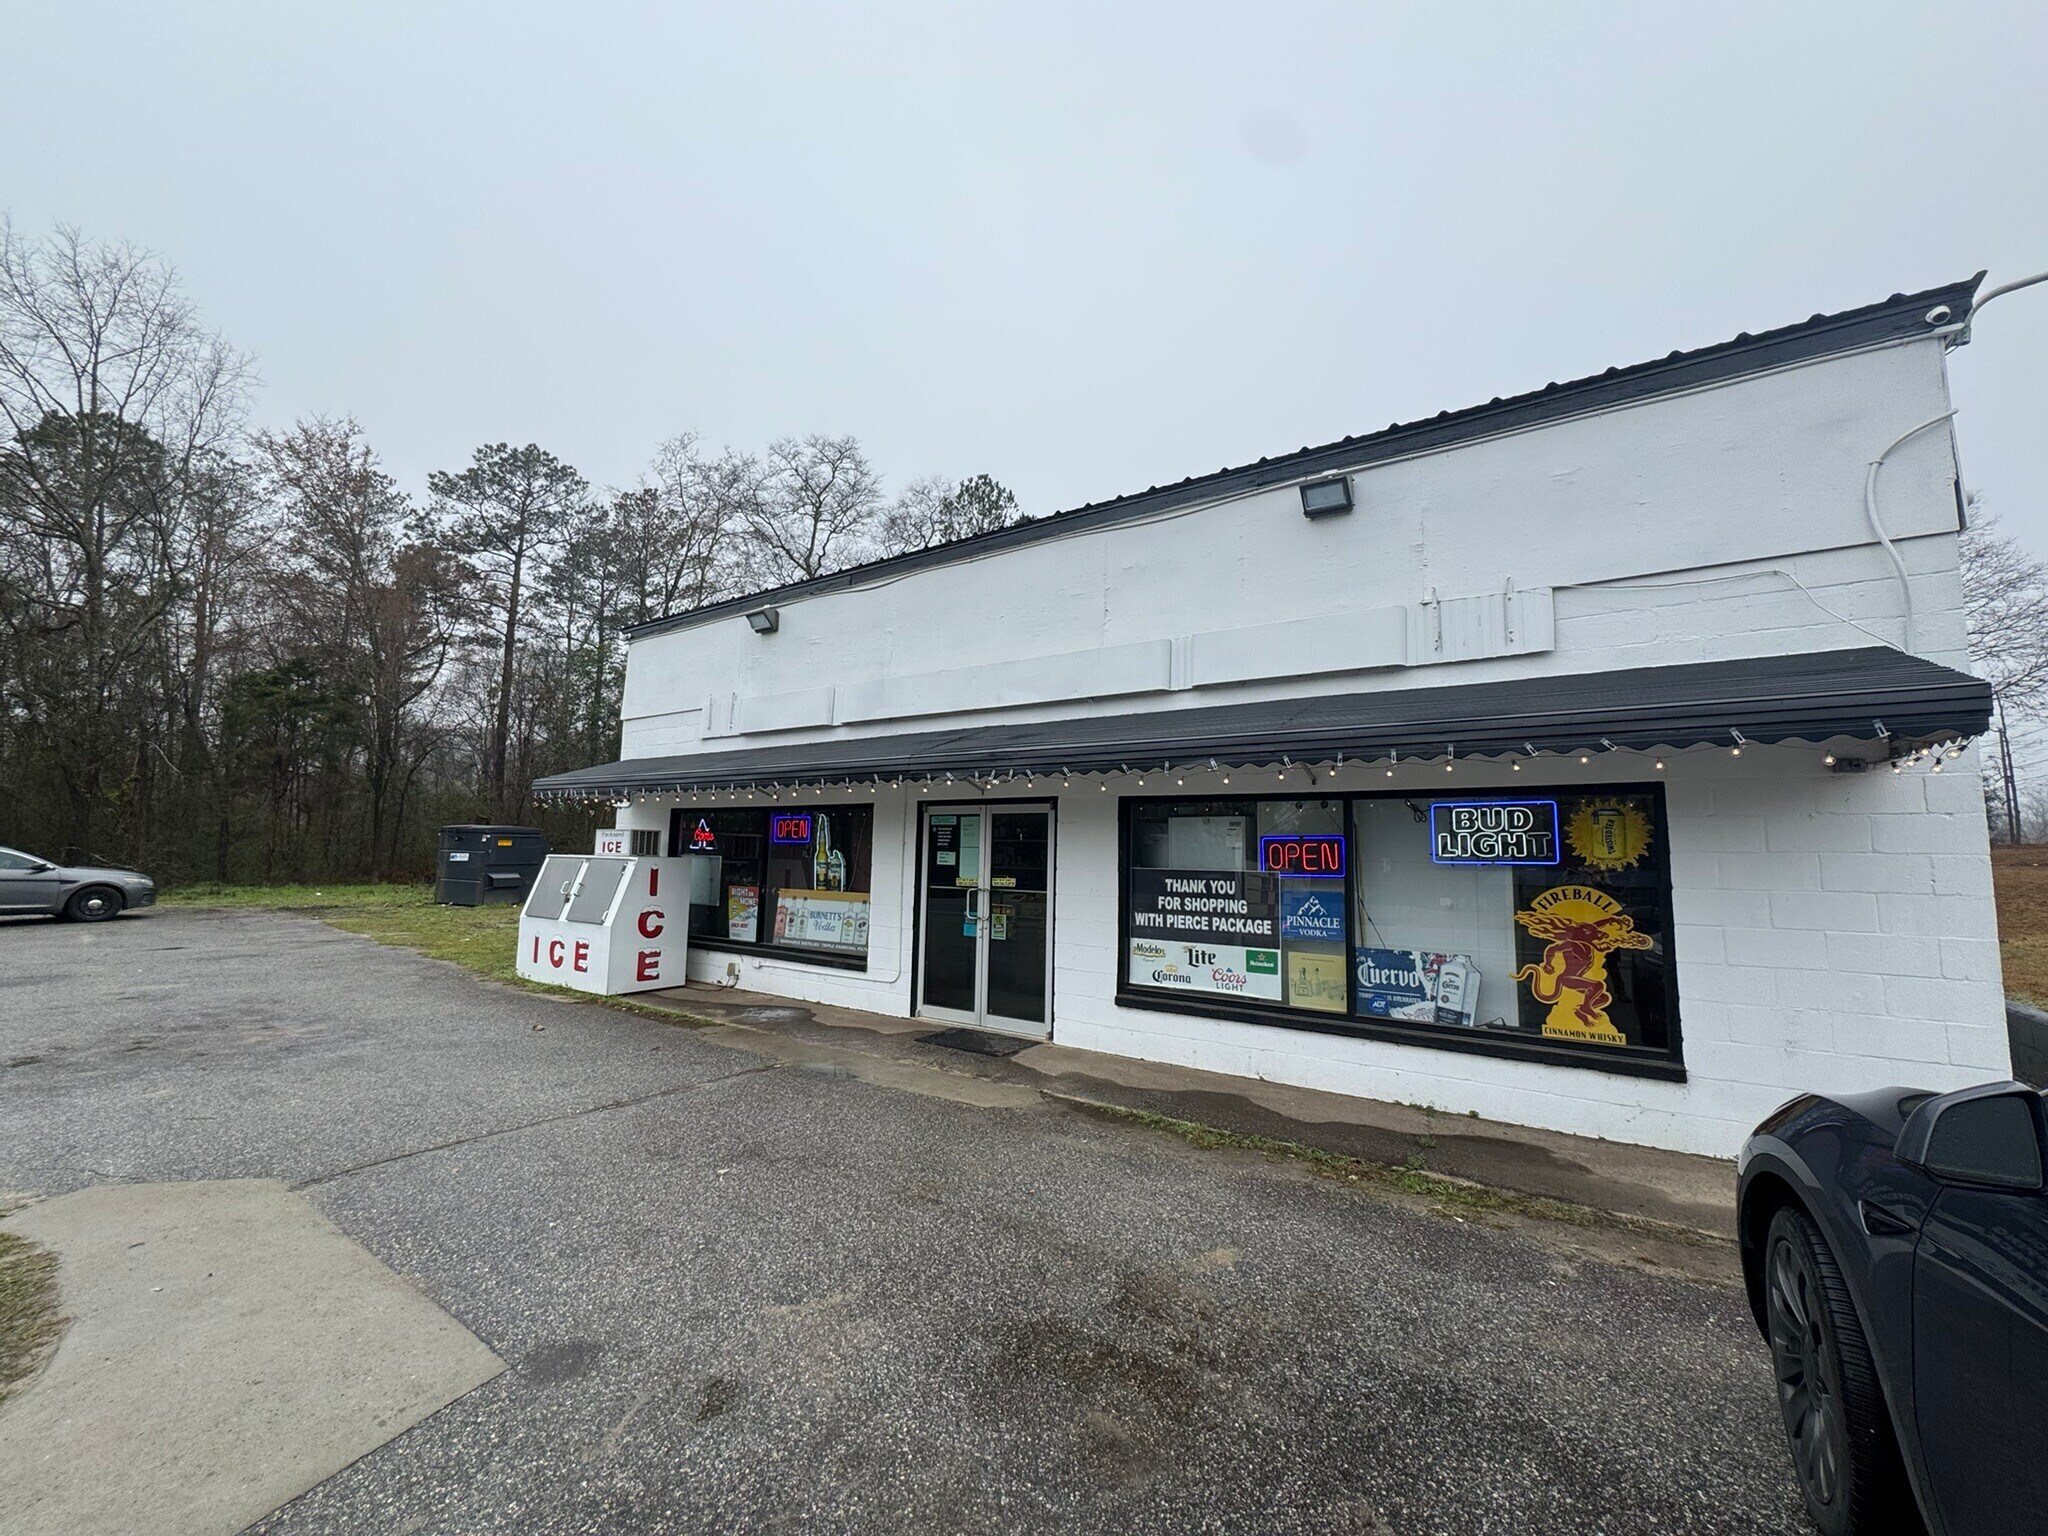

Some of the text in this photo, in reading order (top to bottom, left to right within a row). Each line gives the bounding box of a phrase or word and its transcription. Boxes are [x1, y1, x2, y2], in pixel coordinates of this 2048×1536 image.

[1452, 807, 1533, 832] BUD
[777, 820, 808, 839] OPEN
[602, 841, 622, 853] ICE
[1438, 831, 1551, 858] LIGHT
[1269, 843, 1339, 871] OPEN
[1165, 879, 1236, 895] THANK YOU
[1158, 896, 1248, 914] FOR SHOPPING
[1537, 888, 1613, 913] FIREBALL
[637, 863, 665, 982] ICE
[809, 910, 842, 921] BURNETT'S
[1135, 912, 1272, 935] WITH PIERCE PACKAGE
[1286, 915, 1340, 929] PINNACLE
[814, 920, 836, 932] Vodka
[1299, 928, 1328, 937] VODKA
[533, 935, 590, 973] ICE
[1136, 943, 1161, 955] Modelo
[1186, 947, 1216, 968] Lite
[1152, 969, 1191, 984] Corona
[1211, 967, 1248, 984] Coors
[1357, 957, 1420, 987] Cuervo
[1216, 982, 1243, 992] LIGHT
[1544, 1027, 1624, 1043] CINNAMON WHISKY
